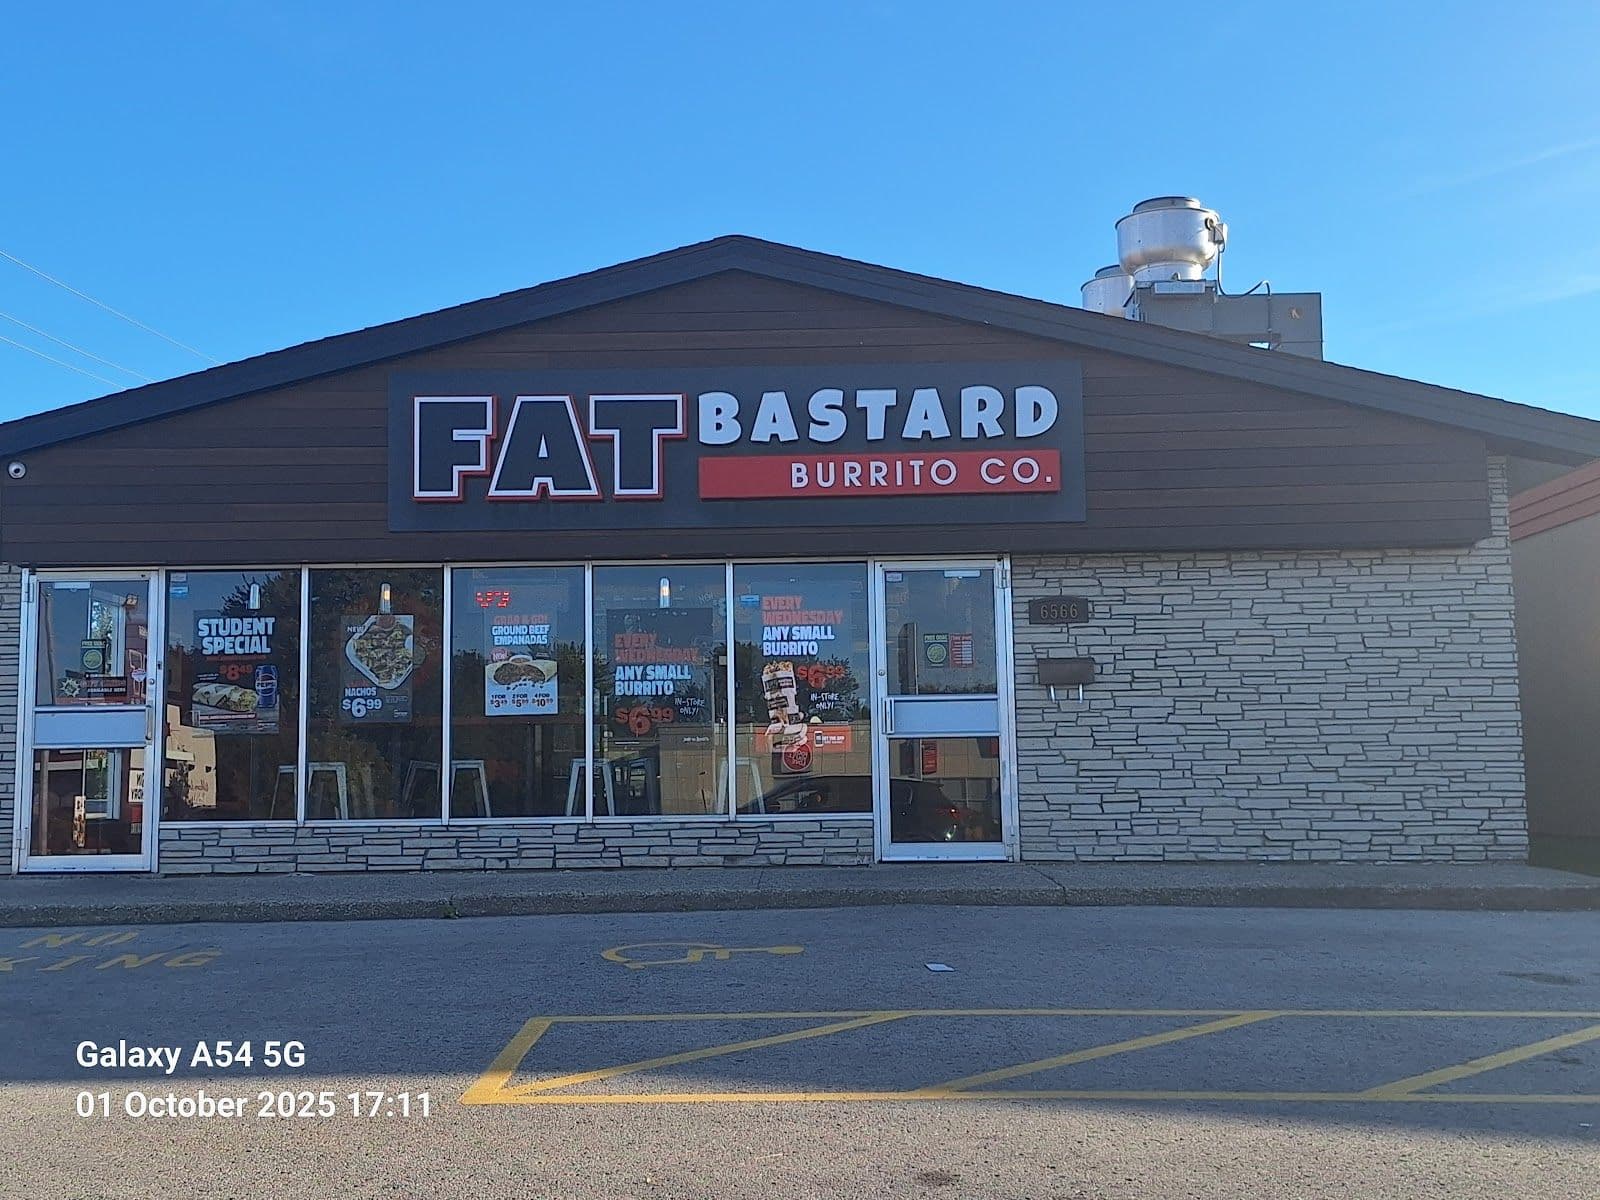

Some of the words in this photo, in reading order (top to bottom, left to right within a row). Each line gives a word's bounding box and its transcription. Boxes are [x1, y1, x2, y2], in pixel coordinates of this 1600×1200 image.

[699, 385, 1058, 445] BASTARD
[412, 394, 687, 501] FAT
[790, 459, 957, 489] BURRITO
[980, 457, 1053, 484] CO.
[763, 596, 802, 609] EVERY
[763, 611, 842, 624] WEDNESDAY
[1040, 603, 1078, 619] 6566
[198, 617, 275, 636] STUDENT
[492, 625, 527, 636] GROUND
[529, 624, 550, 634] BEEF
[763, 626, 788, 640] ANY
[792, 625, 834, 640] SMALL
[202, 635, 271, 654] SPECIAL
[494, 635, 548, 645] EMPANADAS
[763, 641, 818, 656] BURRITO
[615, 666, 644, 680] ANY
[646, 665, 691, 680] SMALL
[345, 687, 377, 697] NACHOS
[615, 680, 673, 695] BURRITO
[811, 693, 839, 701] IN-STORE
[342, 698, 382, 717] $699
